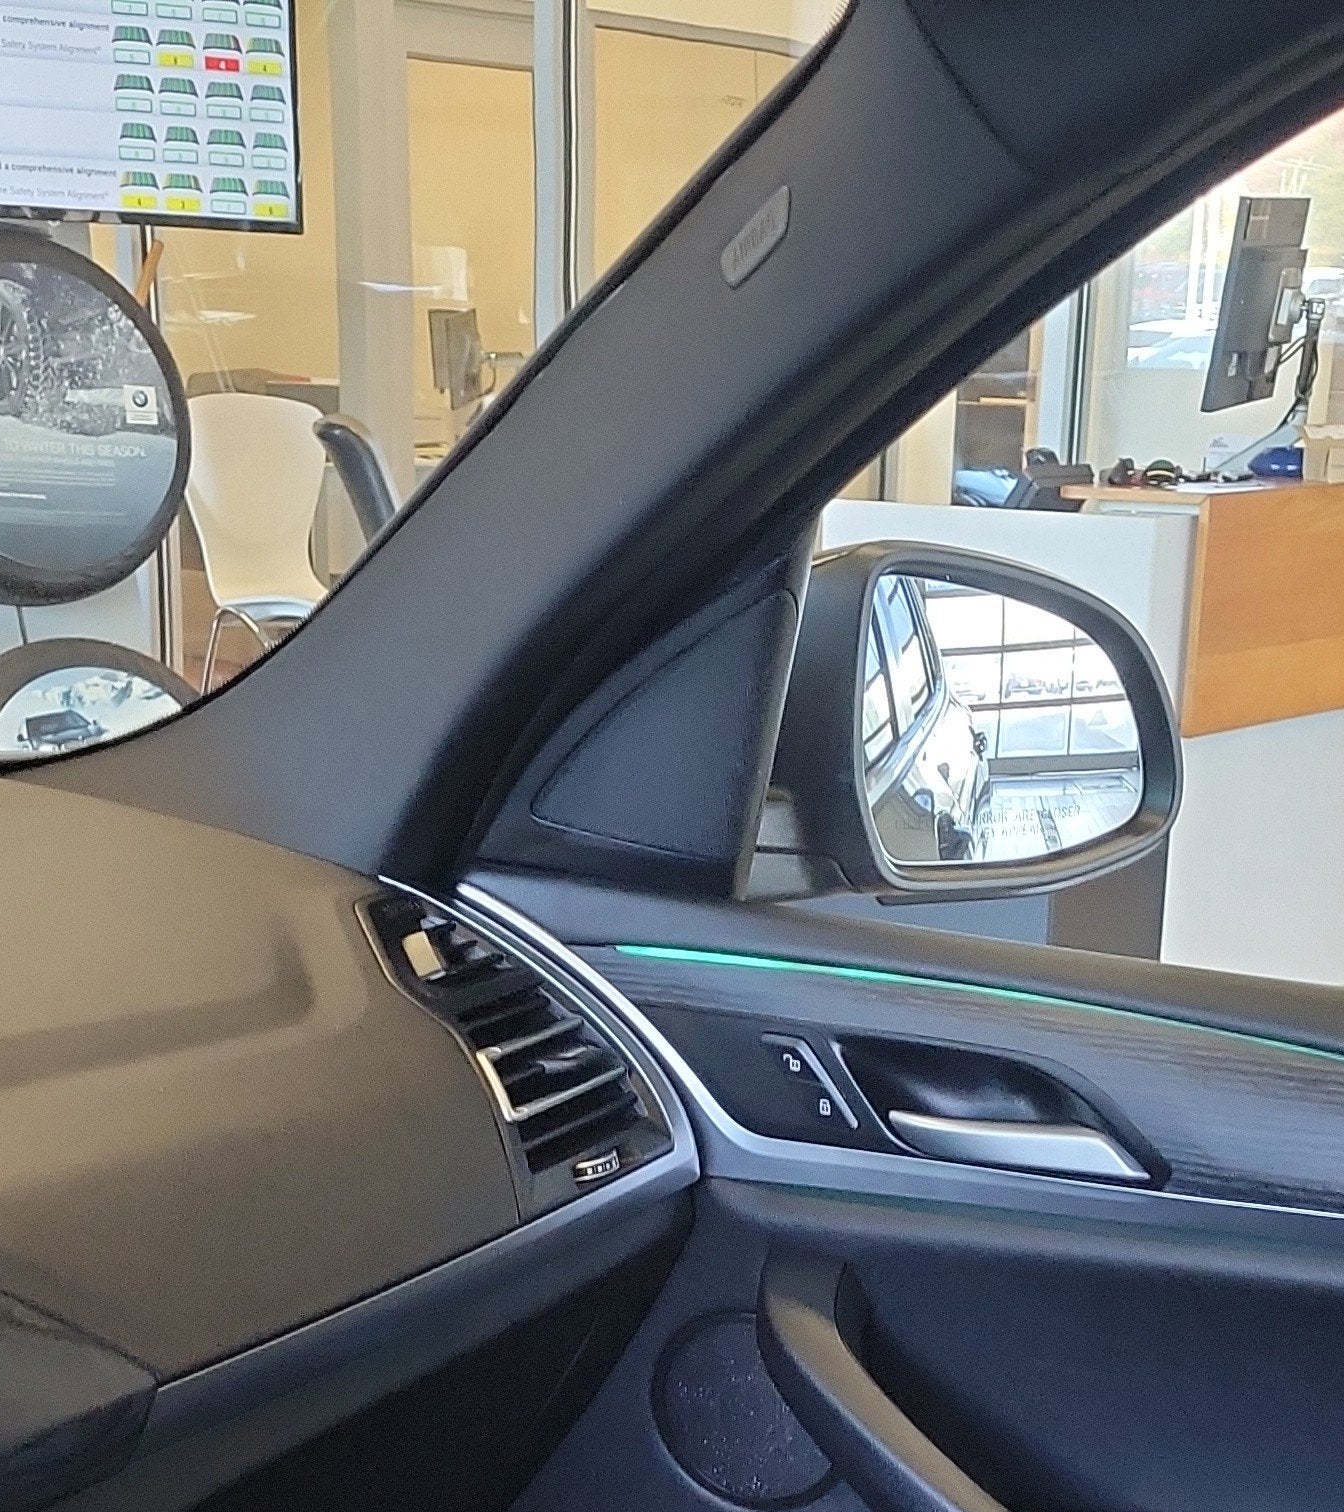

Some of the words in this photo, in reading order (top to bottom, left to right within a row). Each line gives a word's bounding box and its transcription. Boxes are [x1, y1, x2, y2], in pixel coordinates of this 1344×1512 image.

[2, 14, 67, 28] comprehensive
[69, 20, 110, 32] alignment
[1, 38, 26, 50] Safety
[27, 41, 57, 51] System
[11, 163, 74, 175] comprehensive
[76, 167, 117, 178] alignment
[10, 185, 35, 198] Safety
[36, 187, 65, 199] System
[69, 442, 96, 457] THIS
